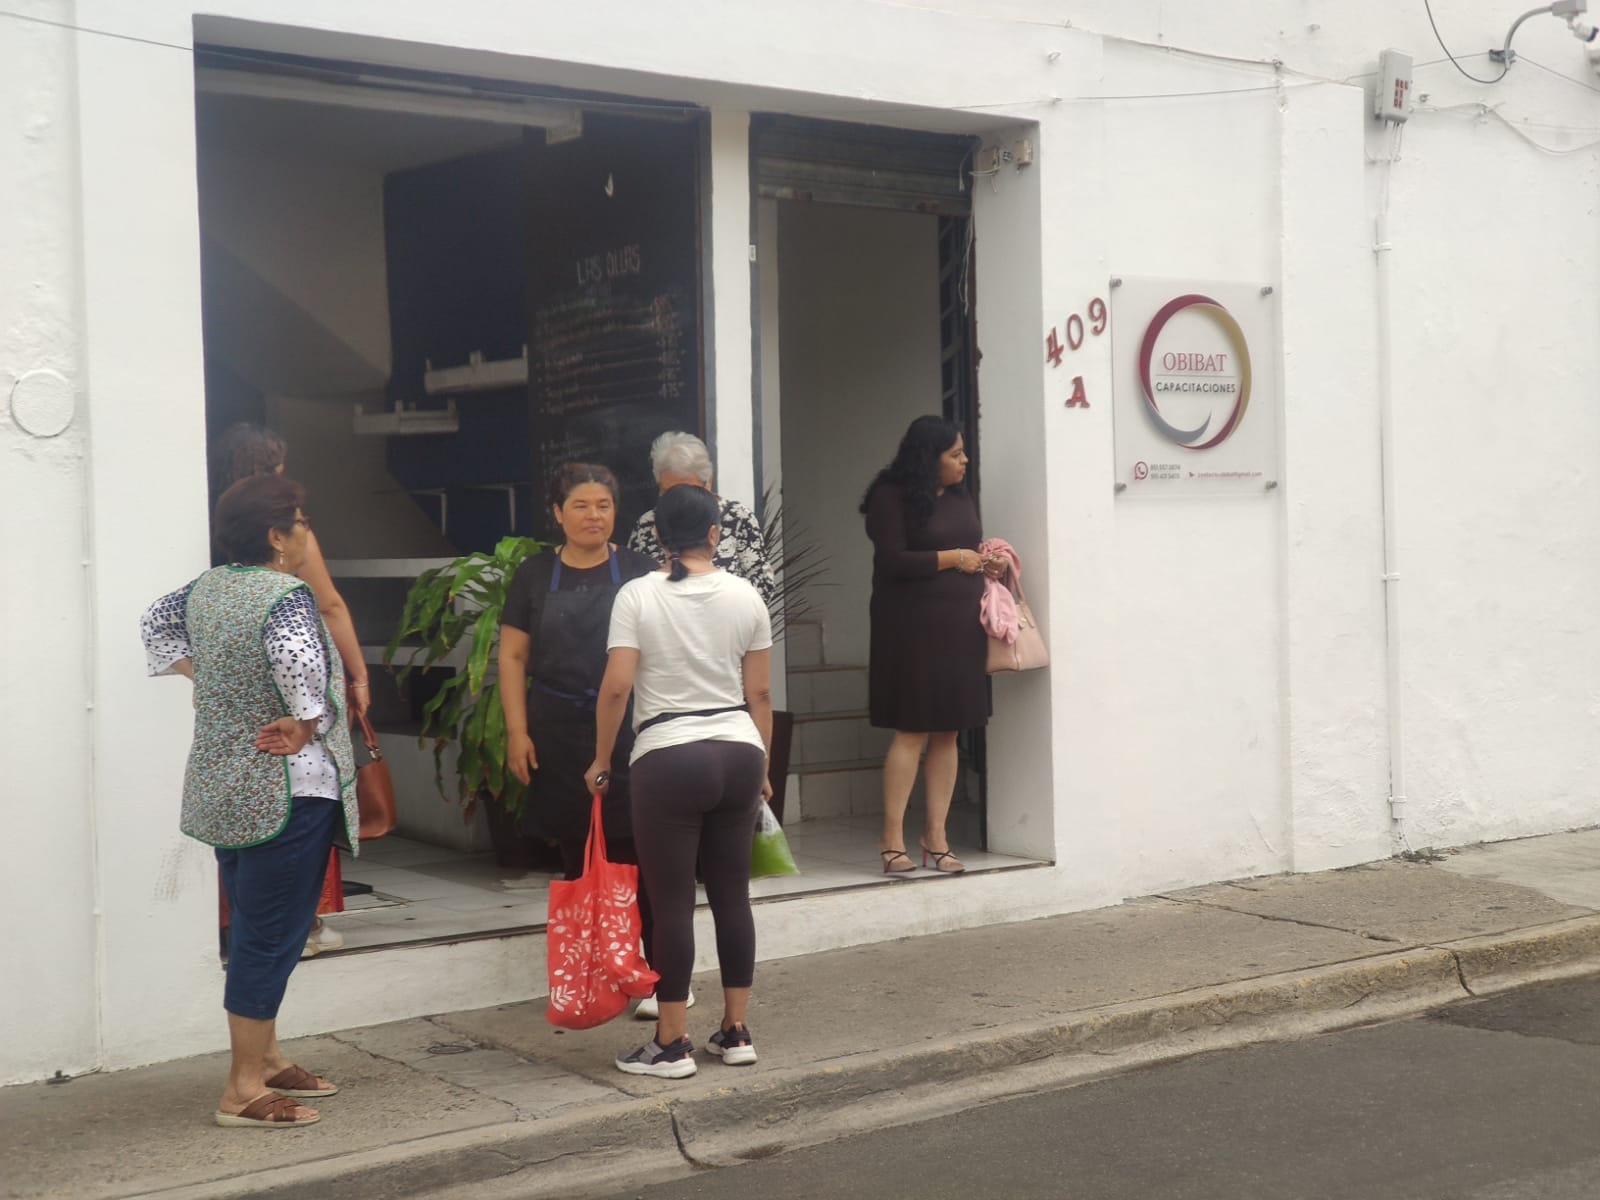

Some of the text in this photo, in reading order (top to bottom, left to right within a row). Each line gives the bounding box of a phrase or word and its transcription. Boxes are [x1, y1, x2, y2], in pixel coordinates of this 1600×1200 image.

[1046, 297, 1107, 368] 409
[1163, 352, 1227, 372] OBIBAT
[1064, 376, 1091, 409] A
[1155, 382, 1236, 394] CAPACITACIONES
